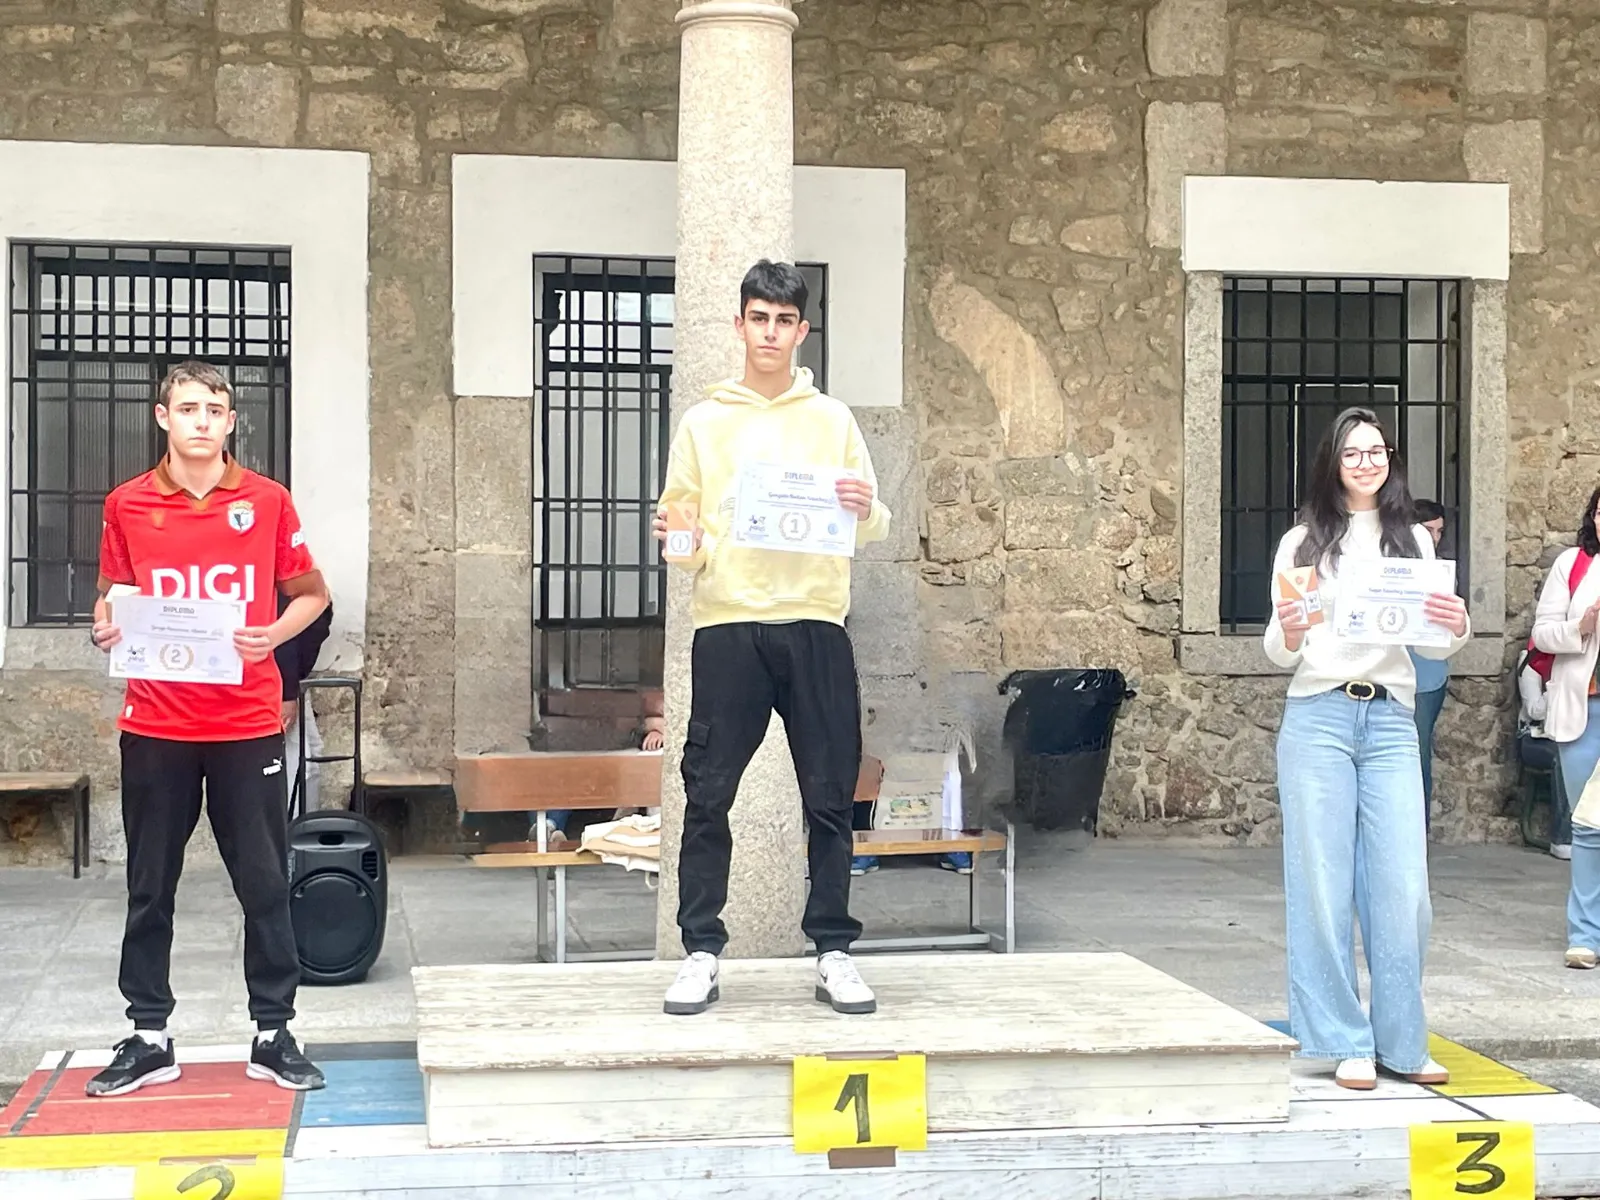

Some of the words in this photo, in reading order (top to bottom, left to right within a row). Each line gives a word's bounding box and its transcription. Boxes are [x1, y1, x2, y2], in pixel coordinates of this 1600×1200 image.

[790, 518, 799, 534] 1
[151, 563, 255, 602] DIGI
[1387, 611, 1396, 626] 3
[171, 649, 181, 663] 2
[834, 1073, 871, 1144] 1
[1455, 1132, 1506, 1194] 3
